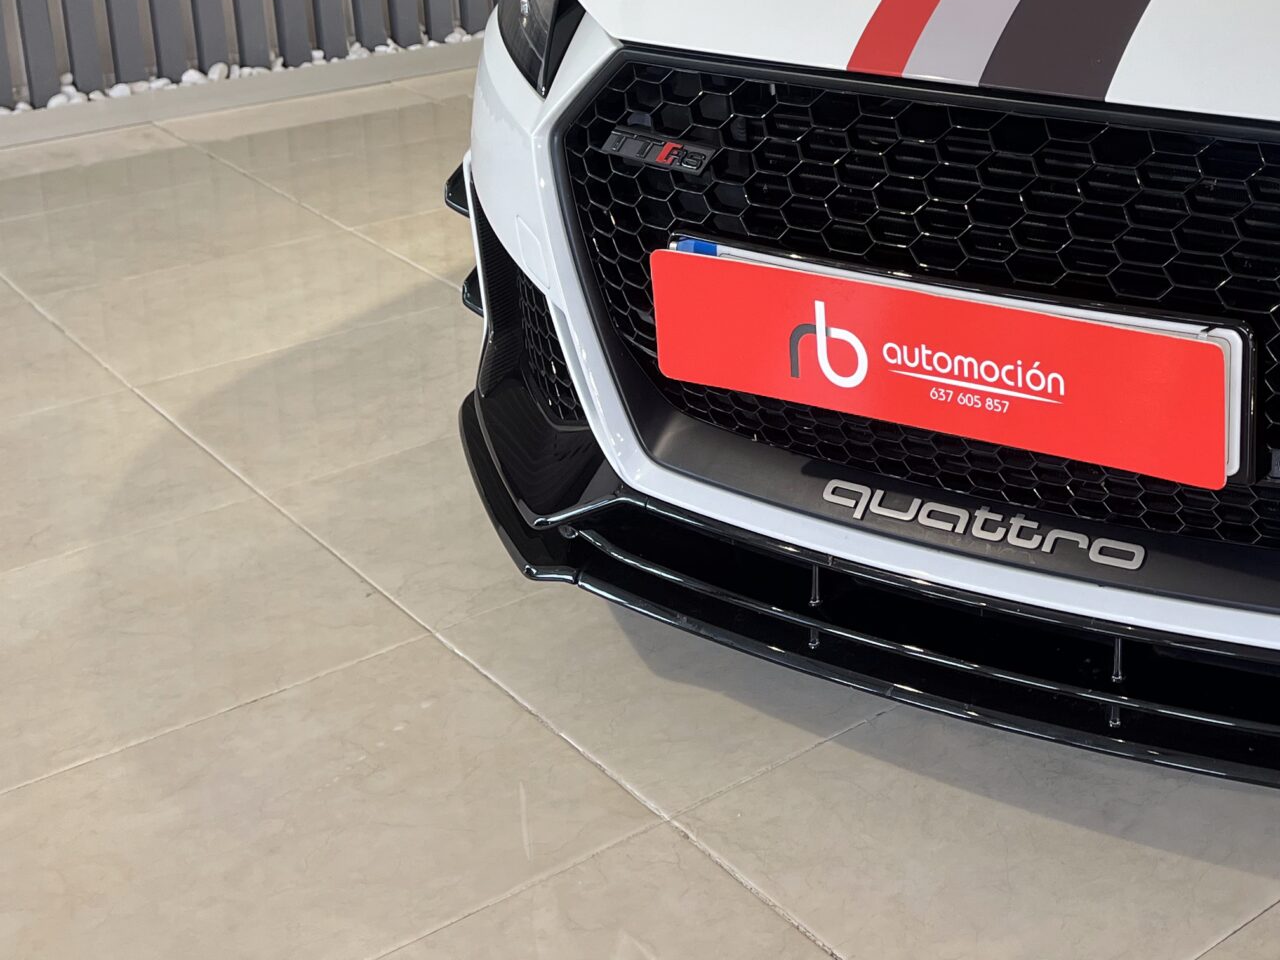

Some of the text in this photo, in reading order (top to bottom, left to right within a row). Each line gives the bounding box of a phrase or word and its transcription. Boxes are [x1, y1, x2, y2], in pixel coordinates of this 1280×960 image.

[881, 341, 1065, 397] automoción
[929, 387, 1010, 414] 637 605 857
[822, 478, 1146, 571] quattro
